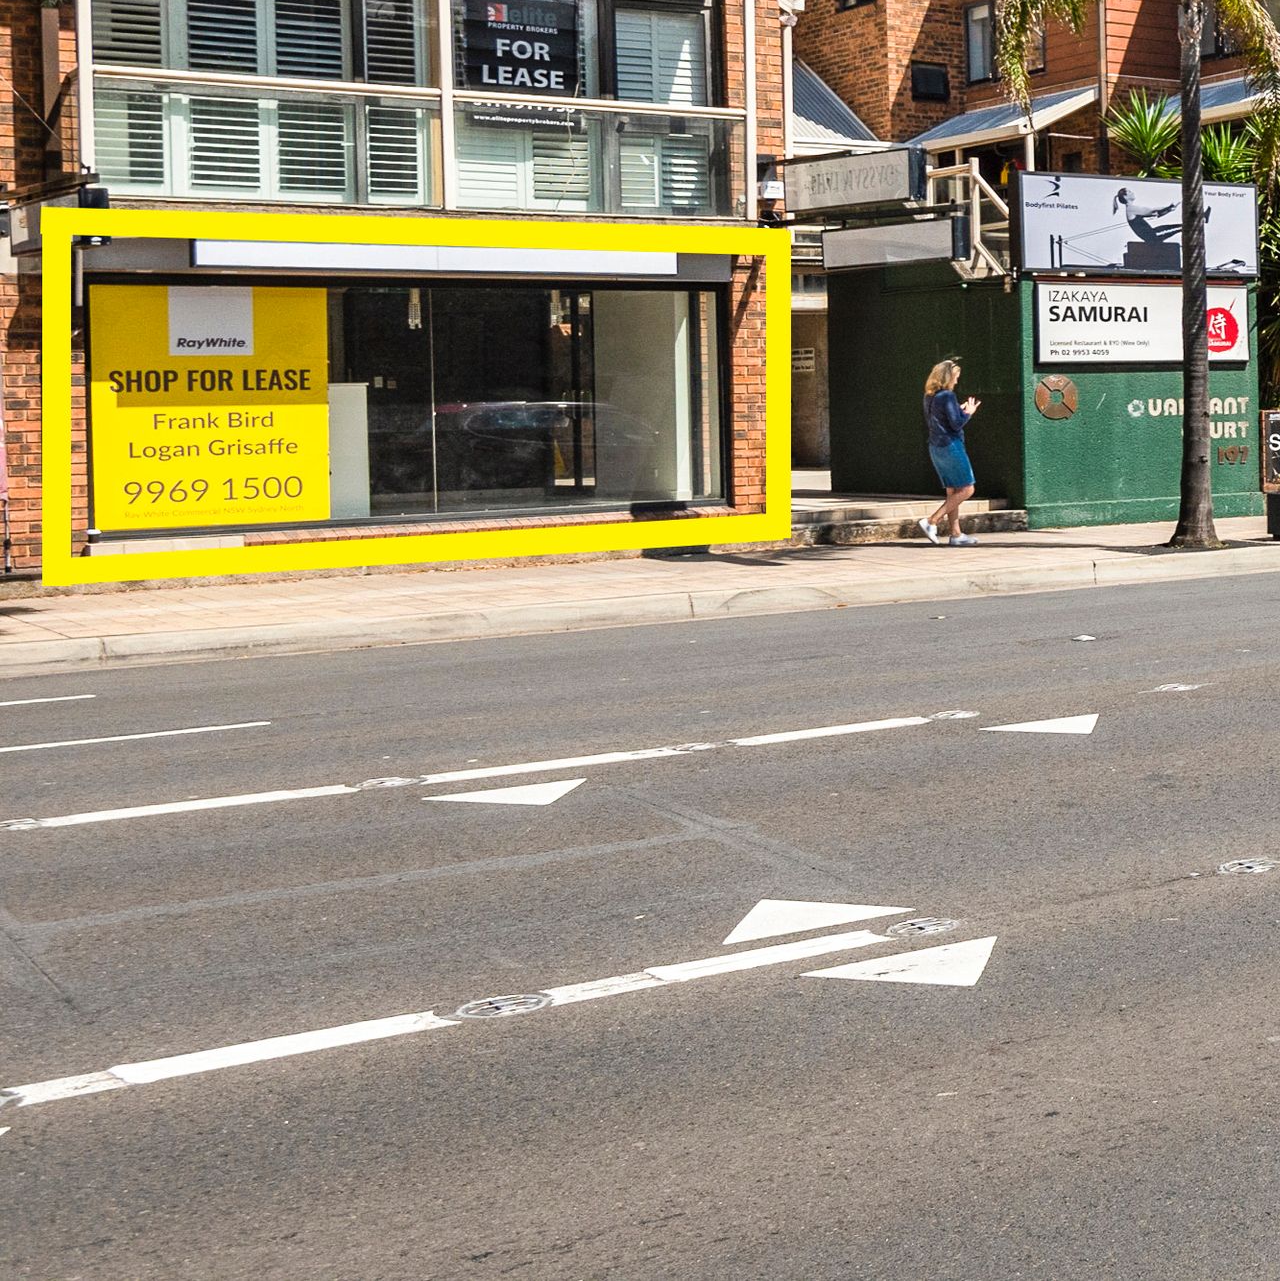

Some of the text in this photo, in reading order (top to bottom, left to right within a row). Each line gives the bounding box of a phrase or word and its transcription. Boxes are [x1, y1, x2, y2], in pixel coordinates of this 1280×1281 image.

[487, 21, 559, 35] PROPERTY BROKERS
[495, 38, 551, 61] FOR
[481, 64, 565, 90] LEASE
[1025, 201, 1055, 211] Bodyfirst
[1049, 290, 1109, 303] IZAKAYA
[1048, 305, 1148, 322] SAMURAI
[175, 337, 247, 350] RayWhite
[108, 368, 312, 393] SHOP FOR LEASE
[152, 411, 274, 430] Frank Bird
[128, 437, 299, 461] Logan Grisaffe
[1216, 444, 1250, 465] 197
[123, 475, 304, 505] 9969 1500
